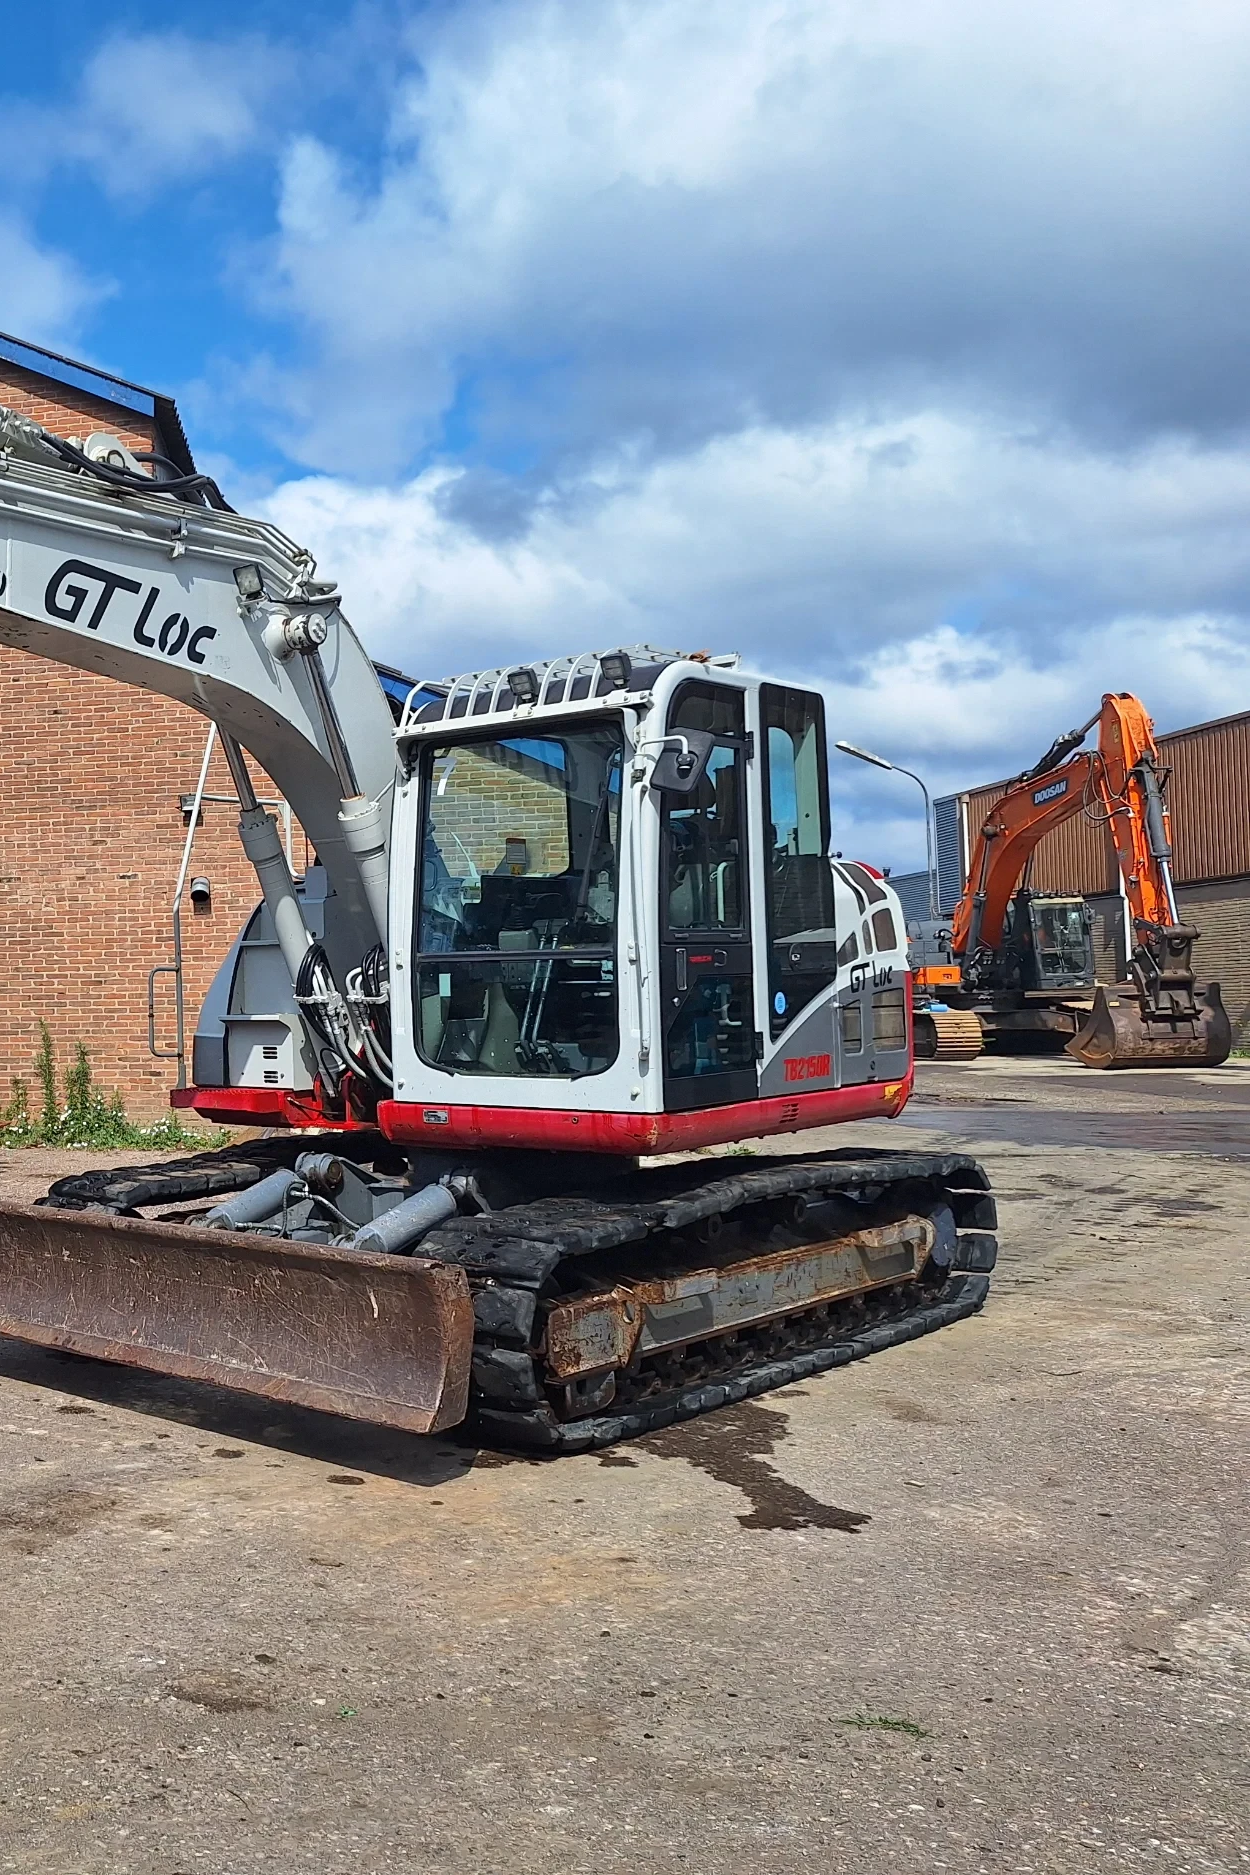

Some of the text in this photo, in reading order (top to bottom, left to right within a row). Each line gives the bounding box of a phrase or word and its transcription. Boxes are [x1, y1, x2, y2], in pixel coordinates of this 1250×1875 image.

[44, 559, 143, 631] GT
[1034, 780, 1067, 804] DOOSAN
[850, 961, 870, 993] GT
